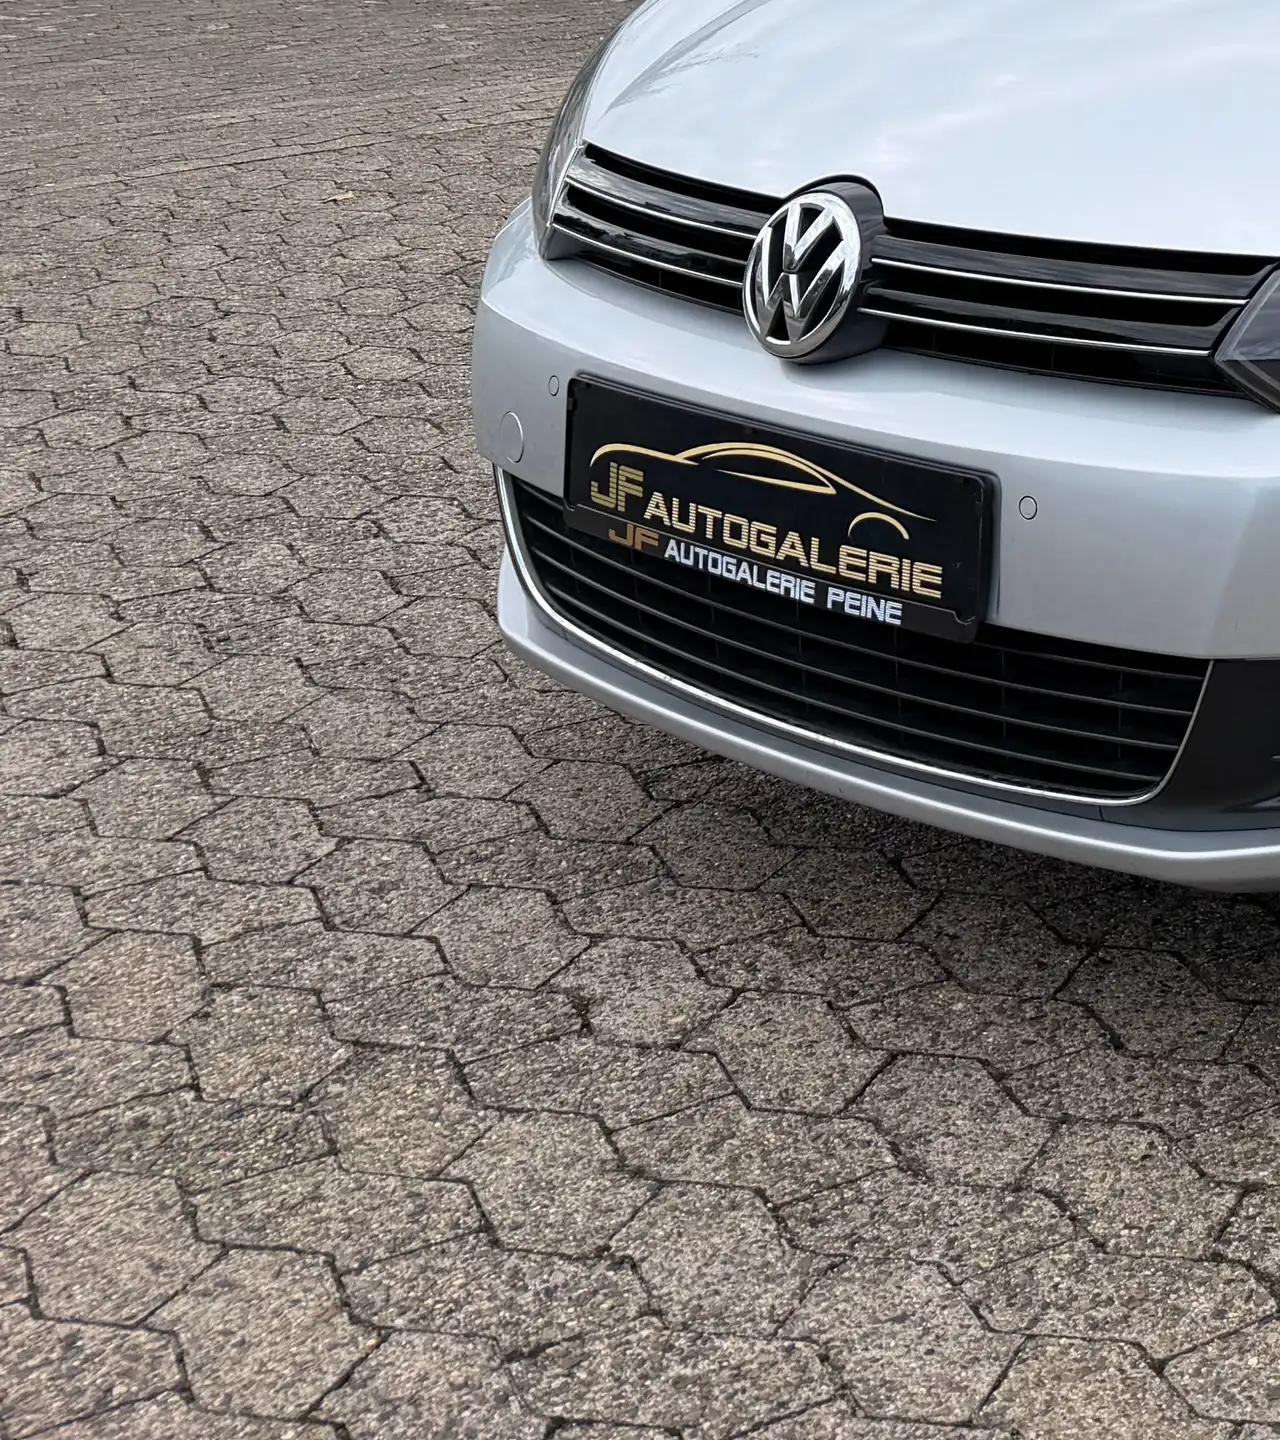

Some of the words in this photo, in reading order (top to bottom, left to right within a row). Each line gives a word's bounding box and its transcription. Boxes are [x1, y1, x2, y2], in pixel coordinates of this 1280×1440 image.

[608, 522, 660, 552] JF
[664, 538, 815, 604] AUTOGALERIE
[826, 586, 903, 626] PEINE
[643, 491, 943, 599] AUTOGALERIE
